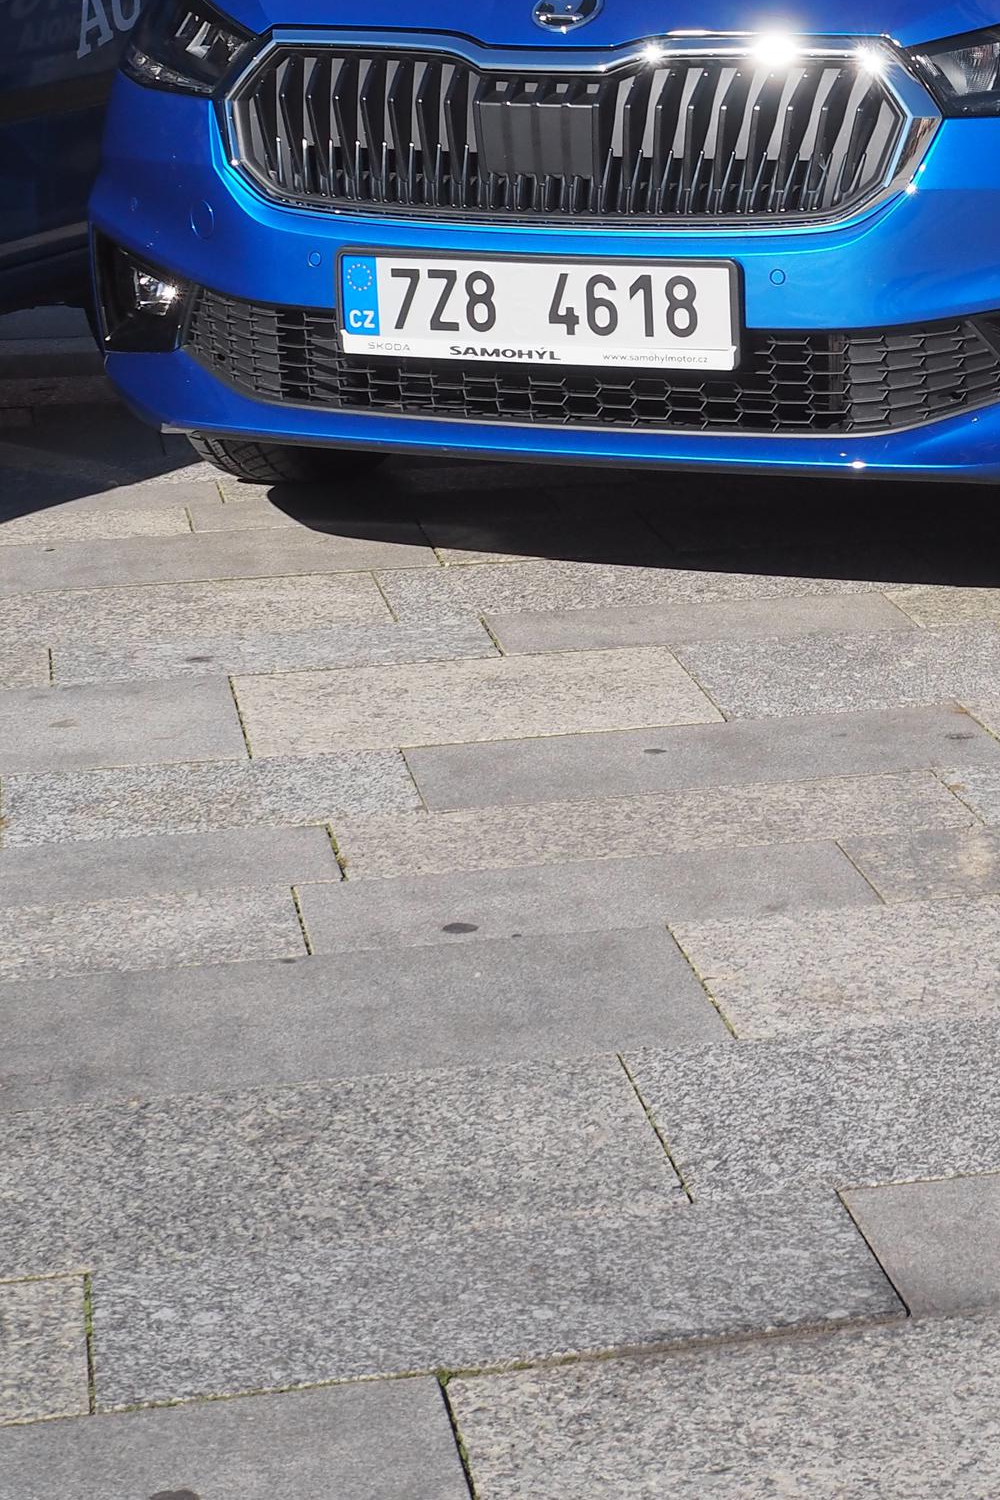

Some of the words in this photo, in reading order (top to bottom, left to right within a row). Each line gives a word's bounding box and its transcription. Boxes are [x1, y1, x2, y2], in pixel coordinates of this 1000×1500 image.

[390, 267, 497, 333] 7Z8
[548, 273, 698, 338] 4618
[349, 309, 376, 329] CZ
[449, 345, 562, 361] SAMOHÝL
[602, 352, 709, 364] www.samohylmotor.cz
